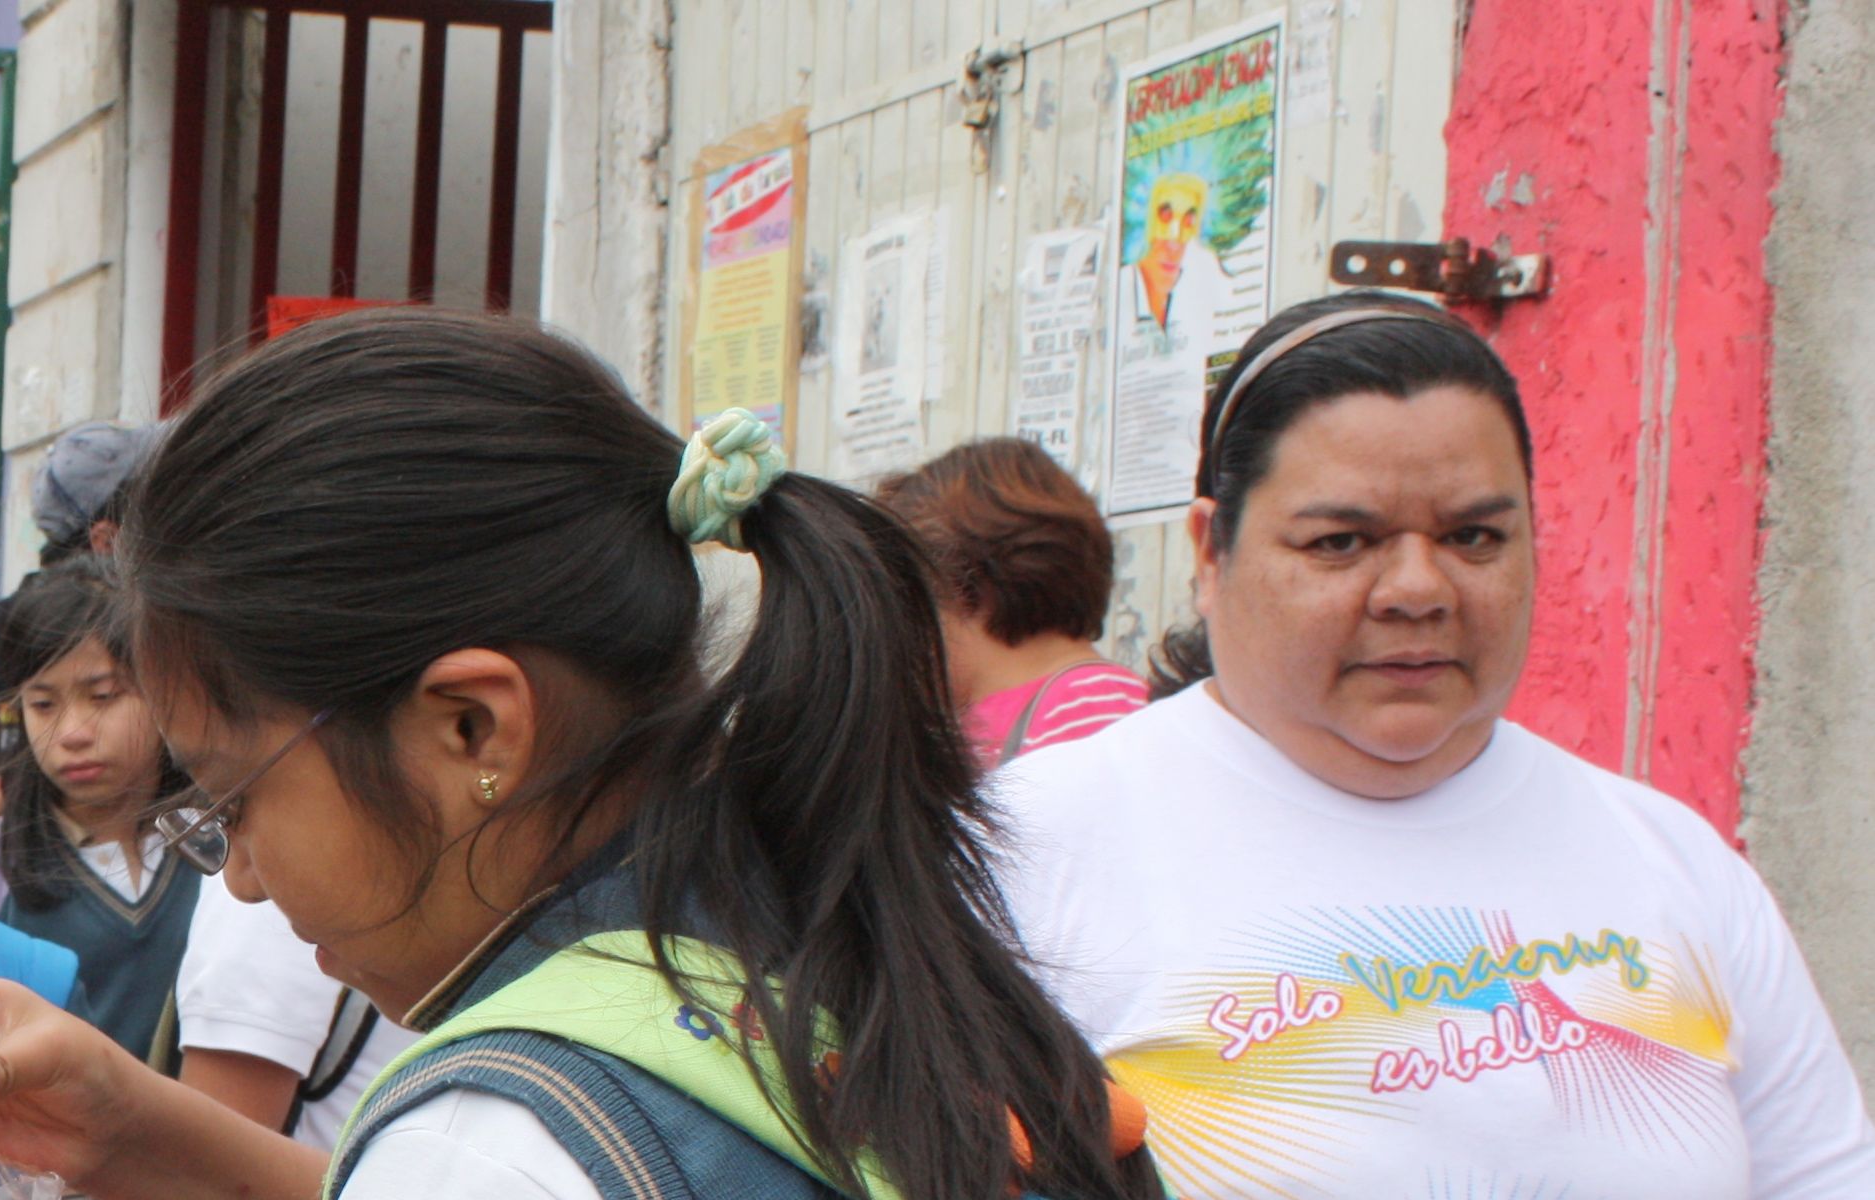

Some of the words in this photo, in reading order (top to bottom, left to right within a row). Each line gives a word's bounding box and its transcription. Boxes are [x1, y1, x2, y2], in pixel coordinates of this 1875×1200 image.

[1208, 972, 1344, 1061] Solo
[1339, 928, 1649, 1016] Veracruz
[1371, 1048, 1438, 1093] es
[1439, 1003, 1588, 1083] bello
